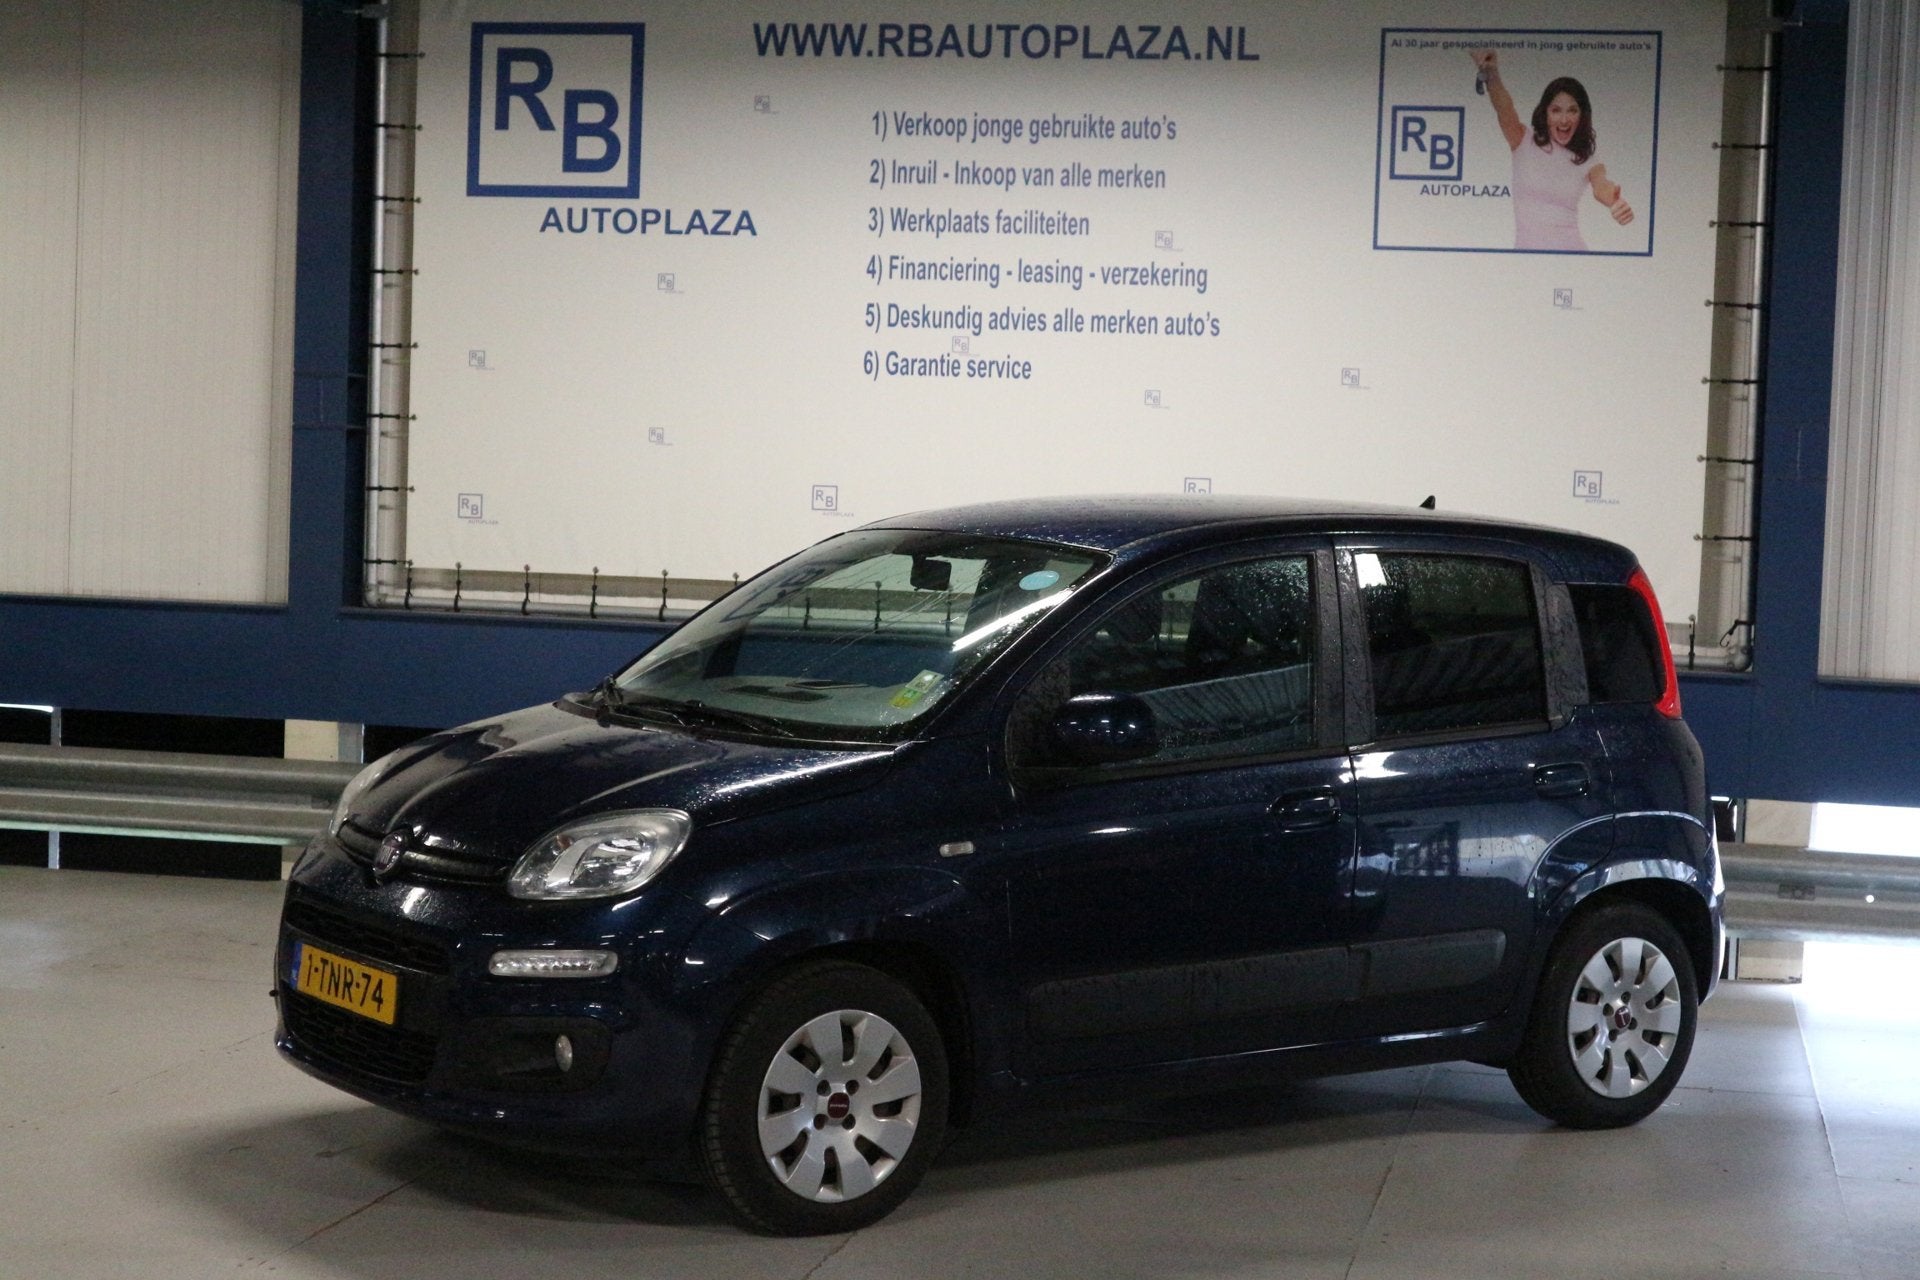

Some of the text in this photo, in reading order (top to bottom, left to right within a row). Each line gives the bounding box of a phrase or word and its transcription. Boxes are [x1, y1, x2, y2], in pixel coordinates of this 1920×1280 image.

[753, 22, 1261, 61] WWW.RBAUTOPLAZA.NL
[1405, 39, 1418, 48] 30
[1420, 39, 1439, 50] jaar
[1527, 41, 1537, 49] in
[1540, 41, 1564, 51] jong
[1566, 41, 1616, 51] gebruikte
[495, 46, 621, 173] RB
[871, 111, 1177, 144] 1) Verkoop jonge gebruikte auto’s
[1401, 116, 1455, 170] RB
[869, 159, 886, 189] 2)
[891, 160, 937, 185] Inruil
[954, 161, 1016, 191] Inkoop
[1022, 169, 1054, 187] van
[1060, 163, 1092, 187] alle
[1098, 164, 1166, 189] merken
[1420, 184, 1511, 197] AUTOPLAZA
[540, 206, 758, 236] AUTOPLAZA
[868, 207, 1090, 238] 3) Werkplaats faciliteiten
[866, 255, 883, 286] 4)
[888, 256, 1000, 289] Financiering
[1017, 258, 1083, 290] leasing
[1100, 261, 1208, 294] verzekering
[865, 303, 1221, 337] 5) Deskundig advies alle merken auto’s
[863, 350, 1033, 381] 6) Garantie service
[815, 490, 834, 507] RB
[1577, 475, 1598, 495] RB
[461, 498, 479, 516] RB
